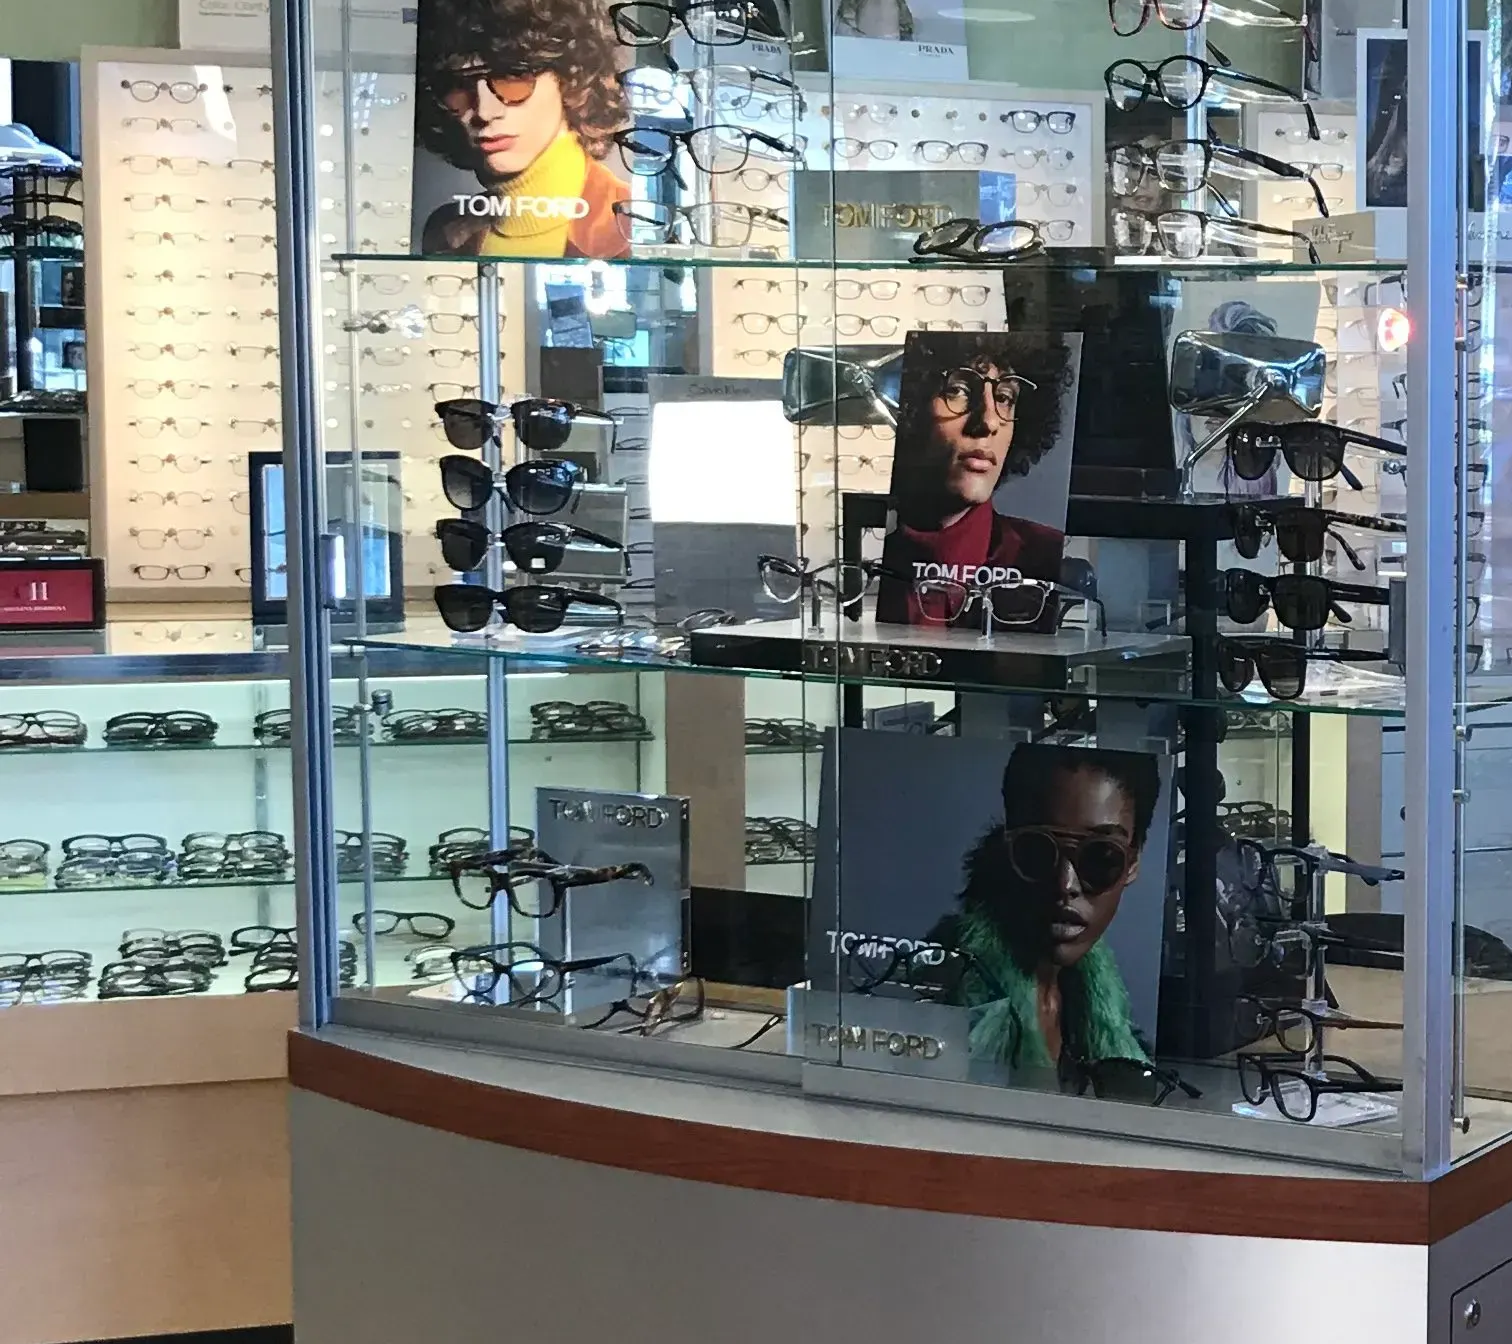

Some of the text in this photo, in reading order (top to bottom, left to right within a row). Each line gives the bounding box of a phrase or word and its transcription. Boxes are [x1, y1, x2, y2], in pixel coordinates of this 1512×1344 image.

[751, 43, 782, 55] PRADA
[918, 44, 954, 55] PRADA
[452, 194, 591, 220] TOM FORD
[912, 562, 958, 583] TOM
[601, 803, 670, 829] FORD
[871, 1029, 946, 1060] FORD
